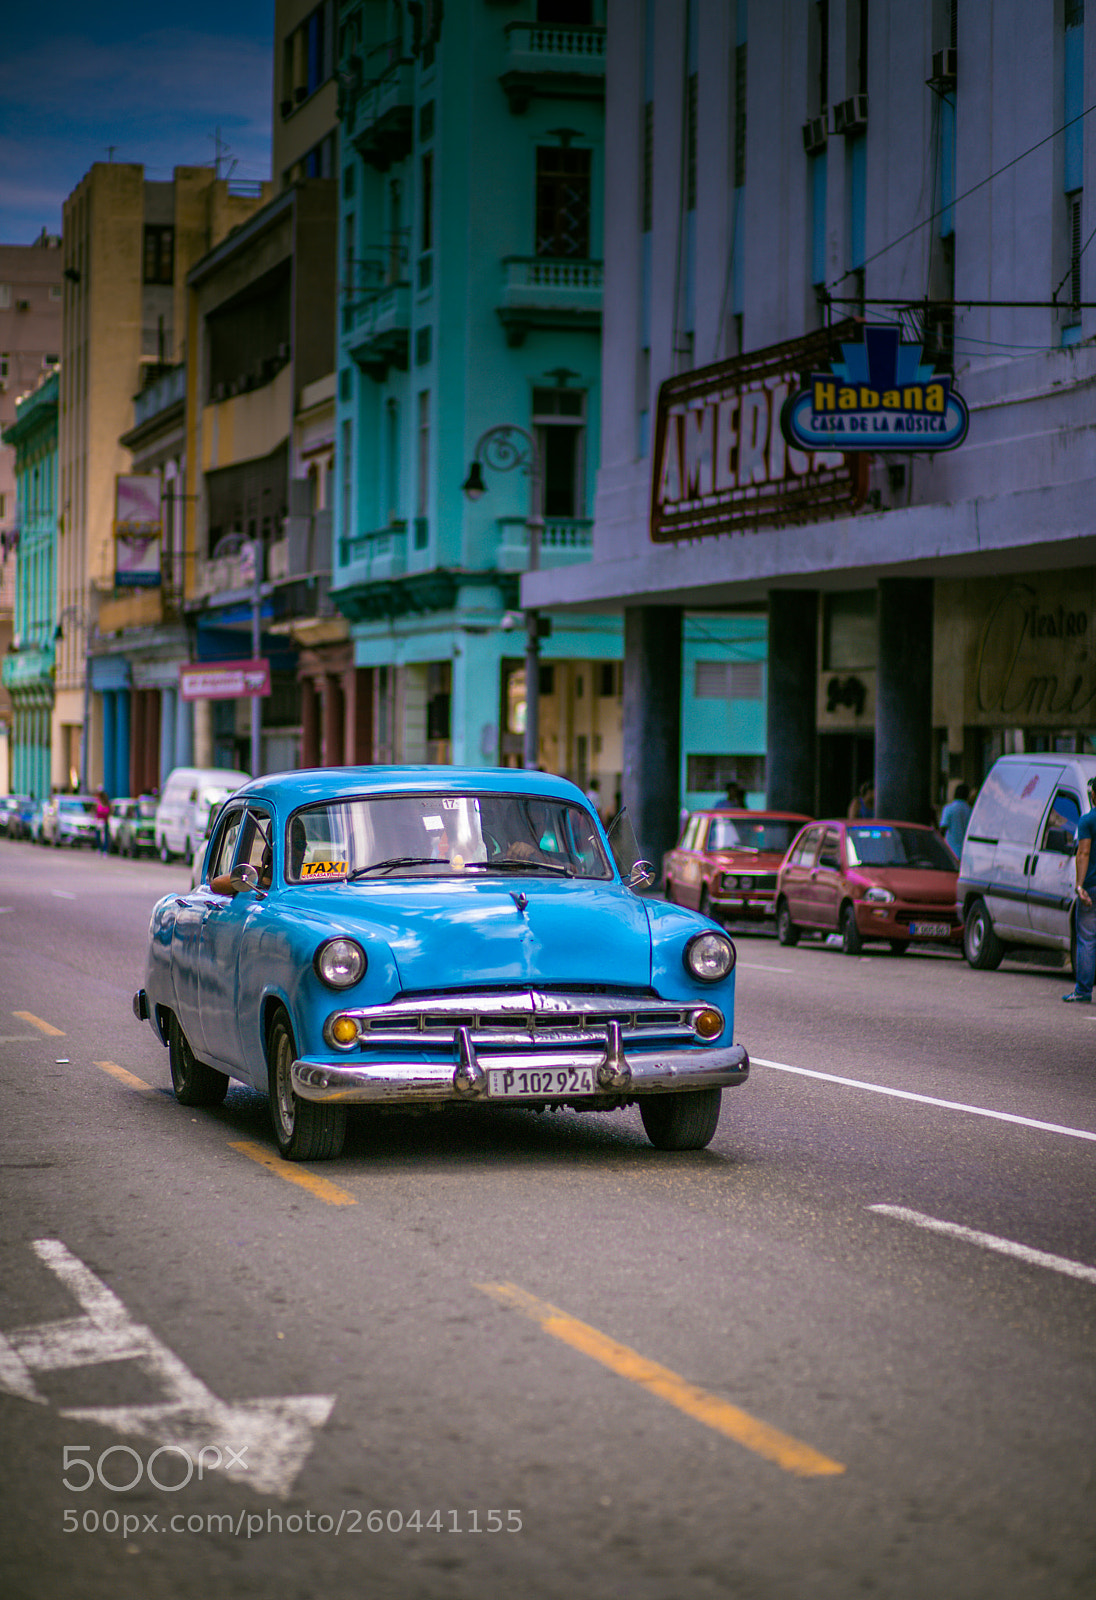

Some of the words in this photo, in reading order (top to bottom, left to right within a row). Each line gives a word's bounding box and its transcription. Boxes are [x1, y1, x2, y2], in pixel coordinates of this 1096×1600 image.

[814, 381, 945, 413] Habana
[810, 416, 847, 432] CASA
[849, 416, 869, 431] DE
[873, 416, 890, 431] LA
[893, 414, 948, 432] MÚSICA
[443, 799, 455, 809] 17
[305, 862, 346, 874] TAXI
